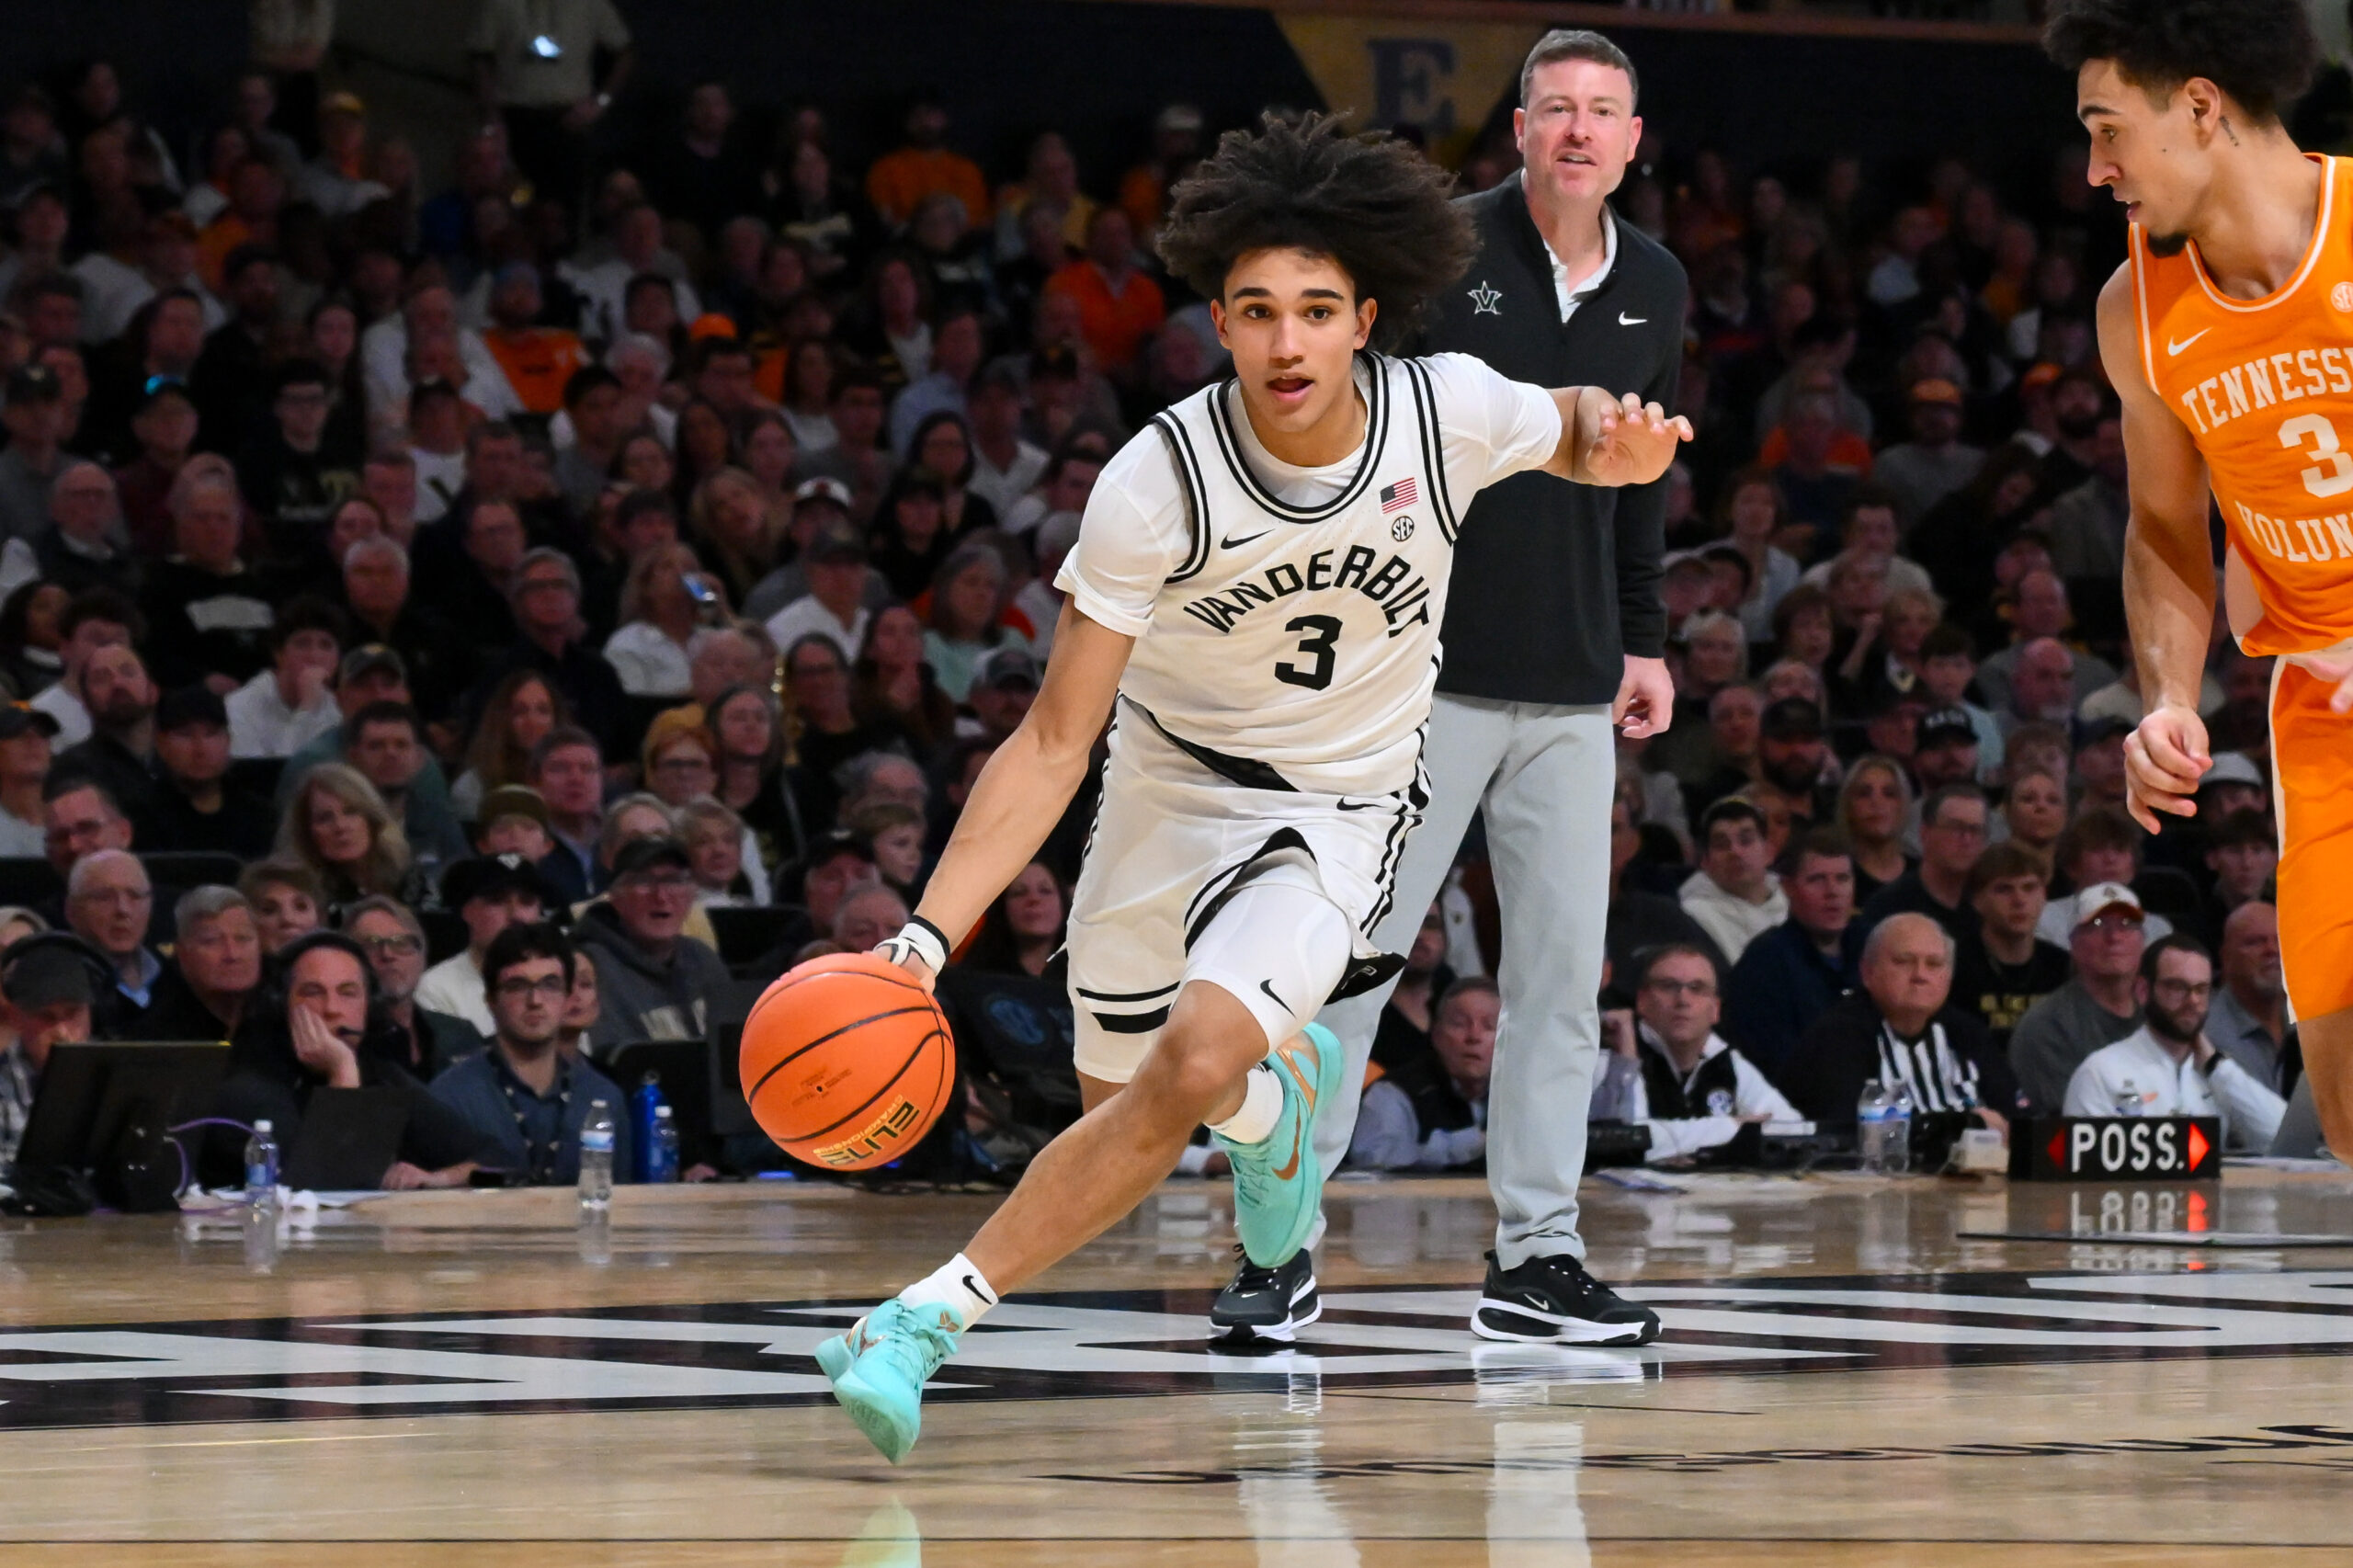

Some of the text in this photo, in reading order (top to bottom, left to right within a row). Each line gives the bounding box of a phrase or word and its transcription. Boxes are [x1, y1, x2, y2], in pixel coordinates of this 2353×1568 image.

[1363, 38, 1457, 136] E
[2181, 347, 2353, 434] TENNESS
[2277, 413, 2353, 498] 3
[1392, 517, 1414, 541] SEC
[2234, 500, 2353, 562] VOLUN
[1183, 544, 1429, 639] VANDERBILT
[1274, 614, 1343, 691] 3
[819, 1101, 920, 1166] ELITE
[2071, 1122, 2185, 1173] POSS.
